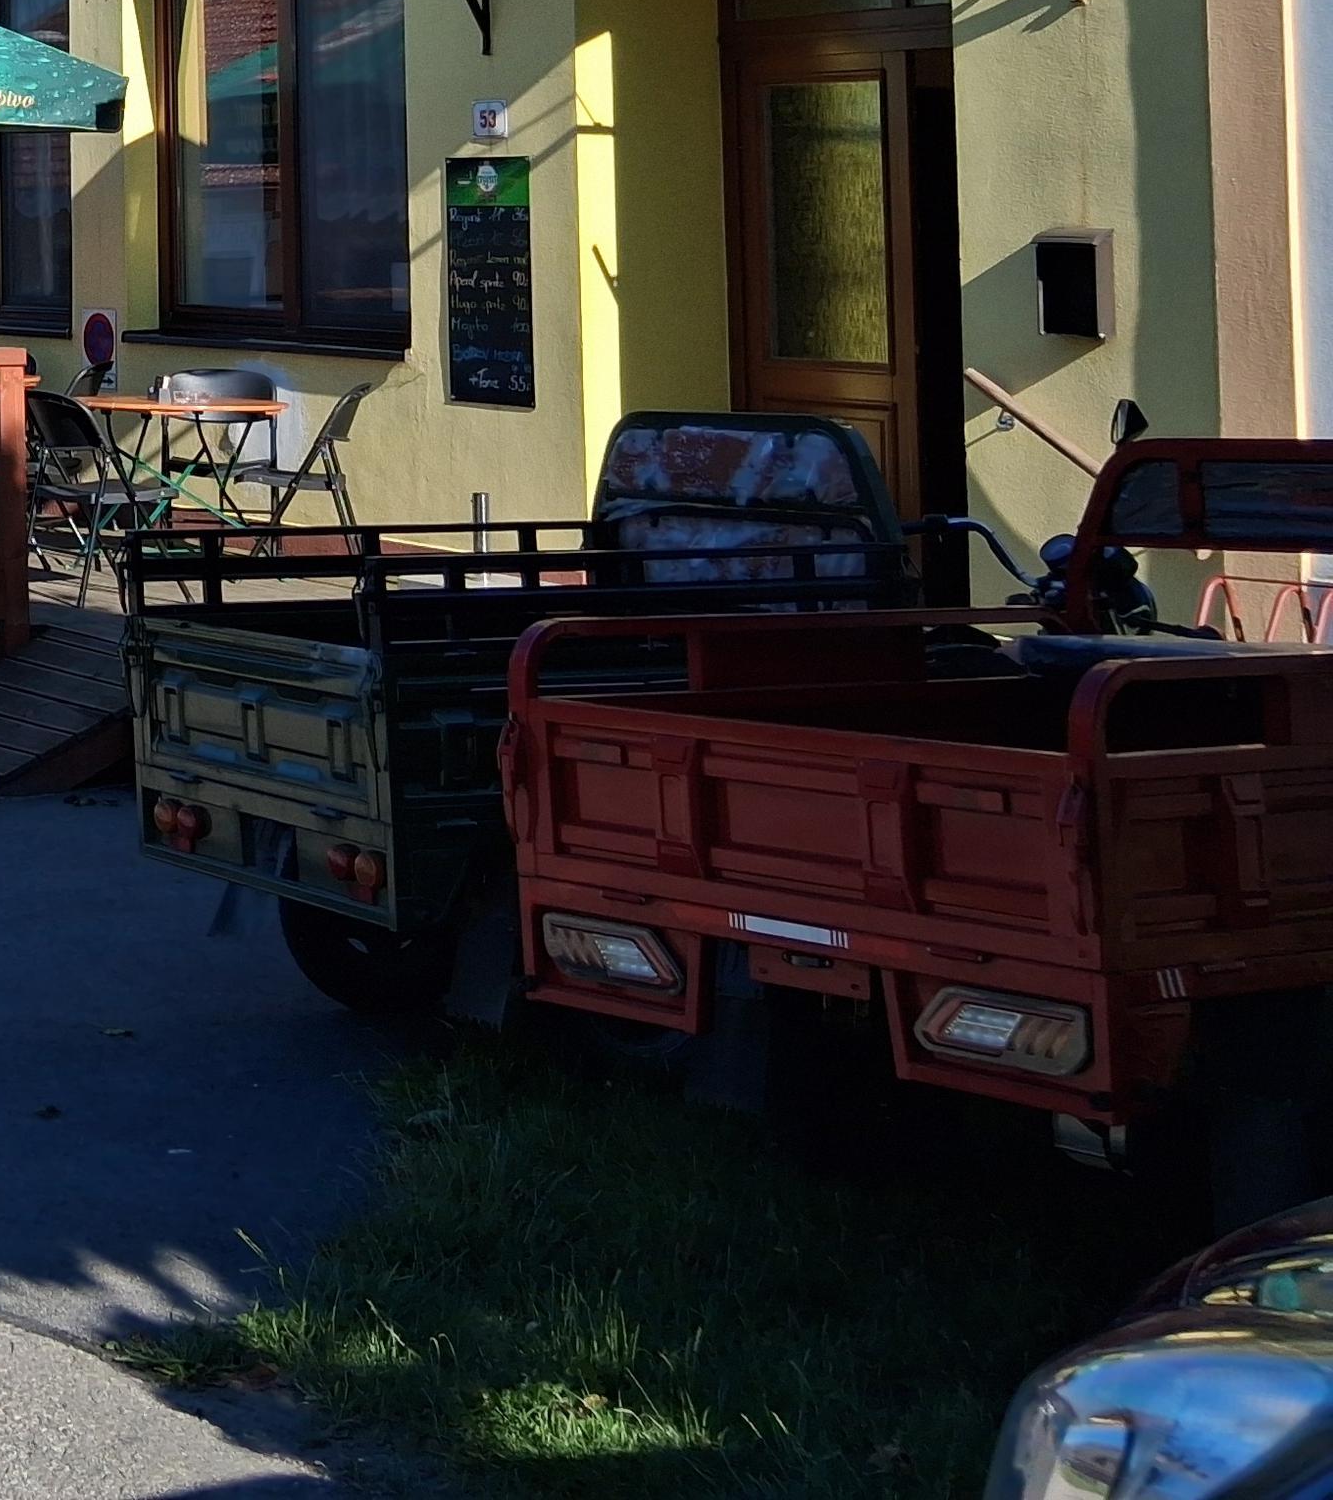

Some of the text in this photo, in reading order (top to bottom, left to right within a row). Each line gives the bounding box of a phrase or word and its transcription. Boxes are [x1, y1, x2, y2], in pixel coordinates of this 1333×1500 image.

[479, 109, 497, 129] 53
[450, 269, 478, 293] Aperol
[450, 293, 477, 315] Hugo
[451, 316, 489, 340] Mojito
